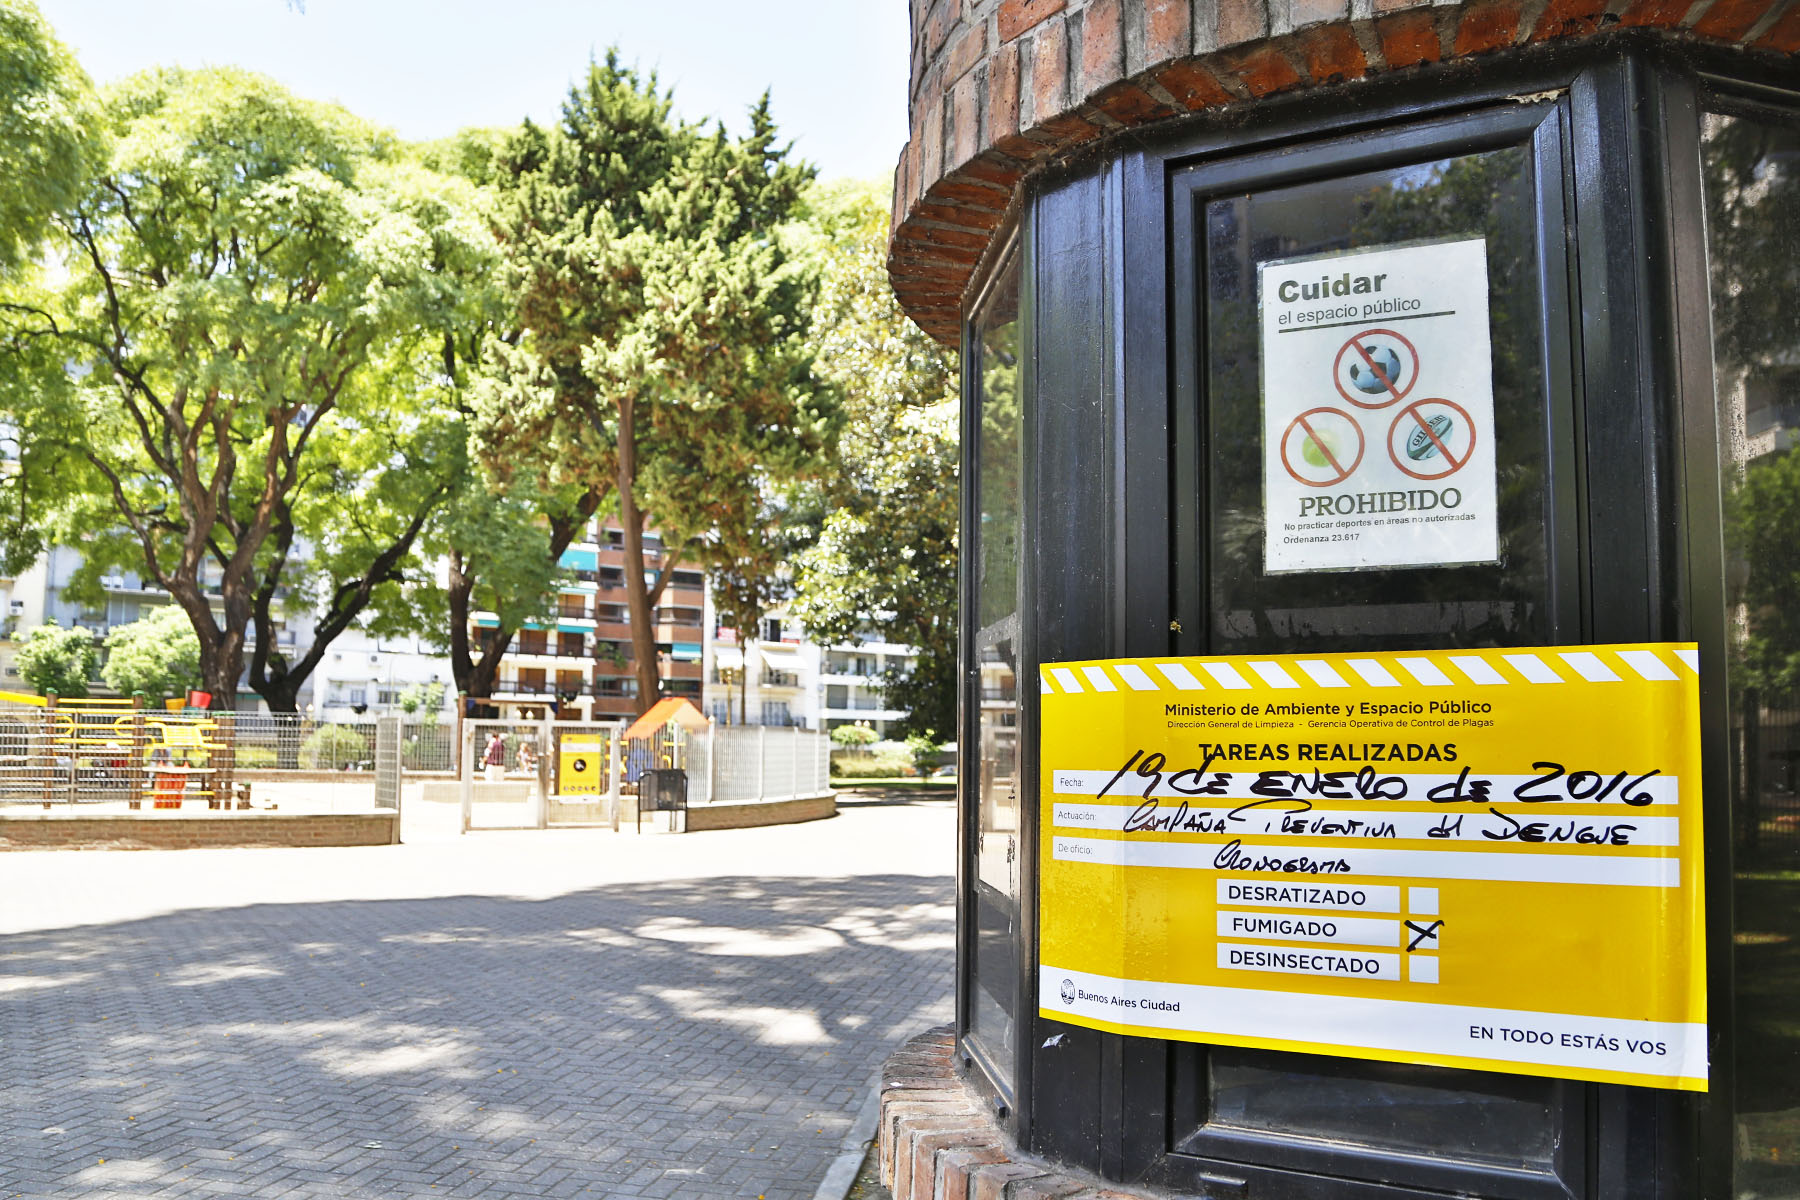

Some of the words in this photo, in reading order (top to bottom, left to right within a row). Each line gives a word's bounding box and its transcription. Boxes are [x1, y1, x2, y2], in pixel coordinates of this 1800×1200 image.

[1278, 273, 1387, 303] Cuidar
[1278, 311, 1291, 325] el
[1297, 304, 1358, 325] espacio
[1363, 298, 1421, 318] público
[1299, 488, 1461, 517] PROHIBIDO
[1284, 523, 1296, 531] No
[1297, 521, 1333, 532] practicar
[1335, 519, 1371, 530] deportes
[1411, 516, 1423, 524] no
[1425, 513, 1476, 523] autorizadas
[1283, 534, 1329, 544] Ordenanza
[1331, 533, 1360, 543] 23.617
[1165, 703, 1236, 717] Ministerio
[1240, 703, 1259, 716] de
[1264, 702, 1340, 716] Ambiente
[1345, 704, 1354, 718] y
[1360, 701, 1424, 718] Espacio
[1429, 700, 1492, 715] Público
[1167, 720, 1206, 728] Dirección
[1208, 720, 1239, 728] General
[1242, 720, 1253, 728] de
[1255, 720, 1294, 730] Limpieza
[1307, 720, 1346, 728] Gerencia
[1349, 719, 1393, 729] Operativa
[1396, 719, 1408, 728] de
[1410, 719, 1445, 728] Control
[1448, 719, 1459, 727] de
[1463, 718, 1494, 729] Plagas
[1198, 743, 1290, 761] TAREAS
[1298, 743, 1457, 762] REALIZADAS
[1060, 777, 1084, 787] Fecha:
[1097, 749, 1167, 799] 19
[1513, 761, 1661, 806] 2016
[1058, 810, 1097, 821] Actuación:
[1481, 808, 1637, 846] DENGUE
[1058, 843, 1068, 853] De
[1070, 844, 1093, 855] oficio:
[1228, 885, 1366, 906] DESRATIZADO
[1232, 917, 1337, 938] FUMIGADO
[1230, 949, 1380, 974] DESINSECTADO
[1078, 989, 1109, 1004] Buenos
[1110, 995, 1137, 1009] Aires
[1140, 998, 1180, 1013] Ciudad
[1469, 1025, 1494, 1040] EN
[1500, 1028, 1554, 1045] TODO
[1560, 1033, 1620, 1052] ESTÁS
[1626, 1039, 1667, 1056] VOS
